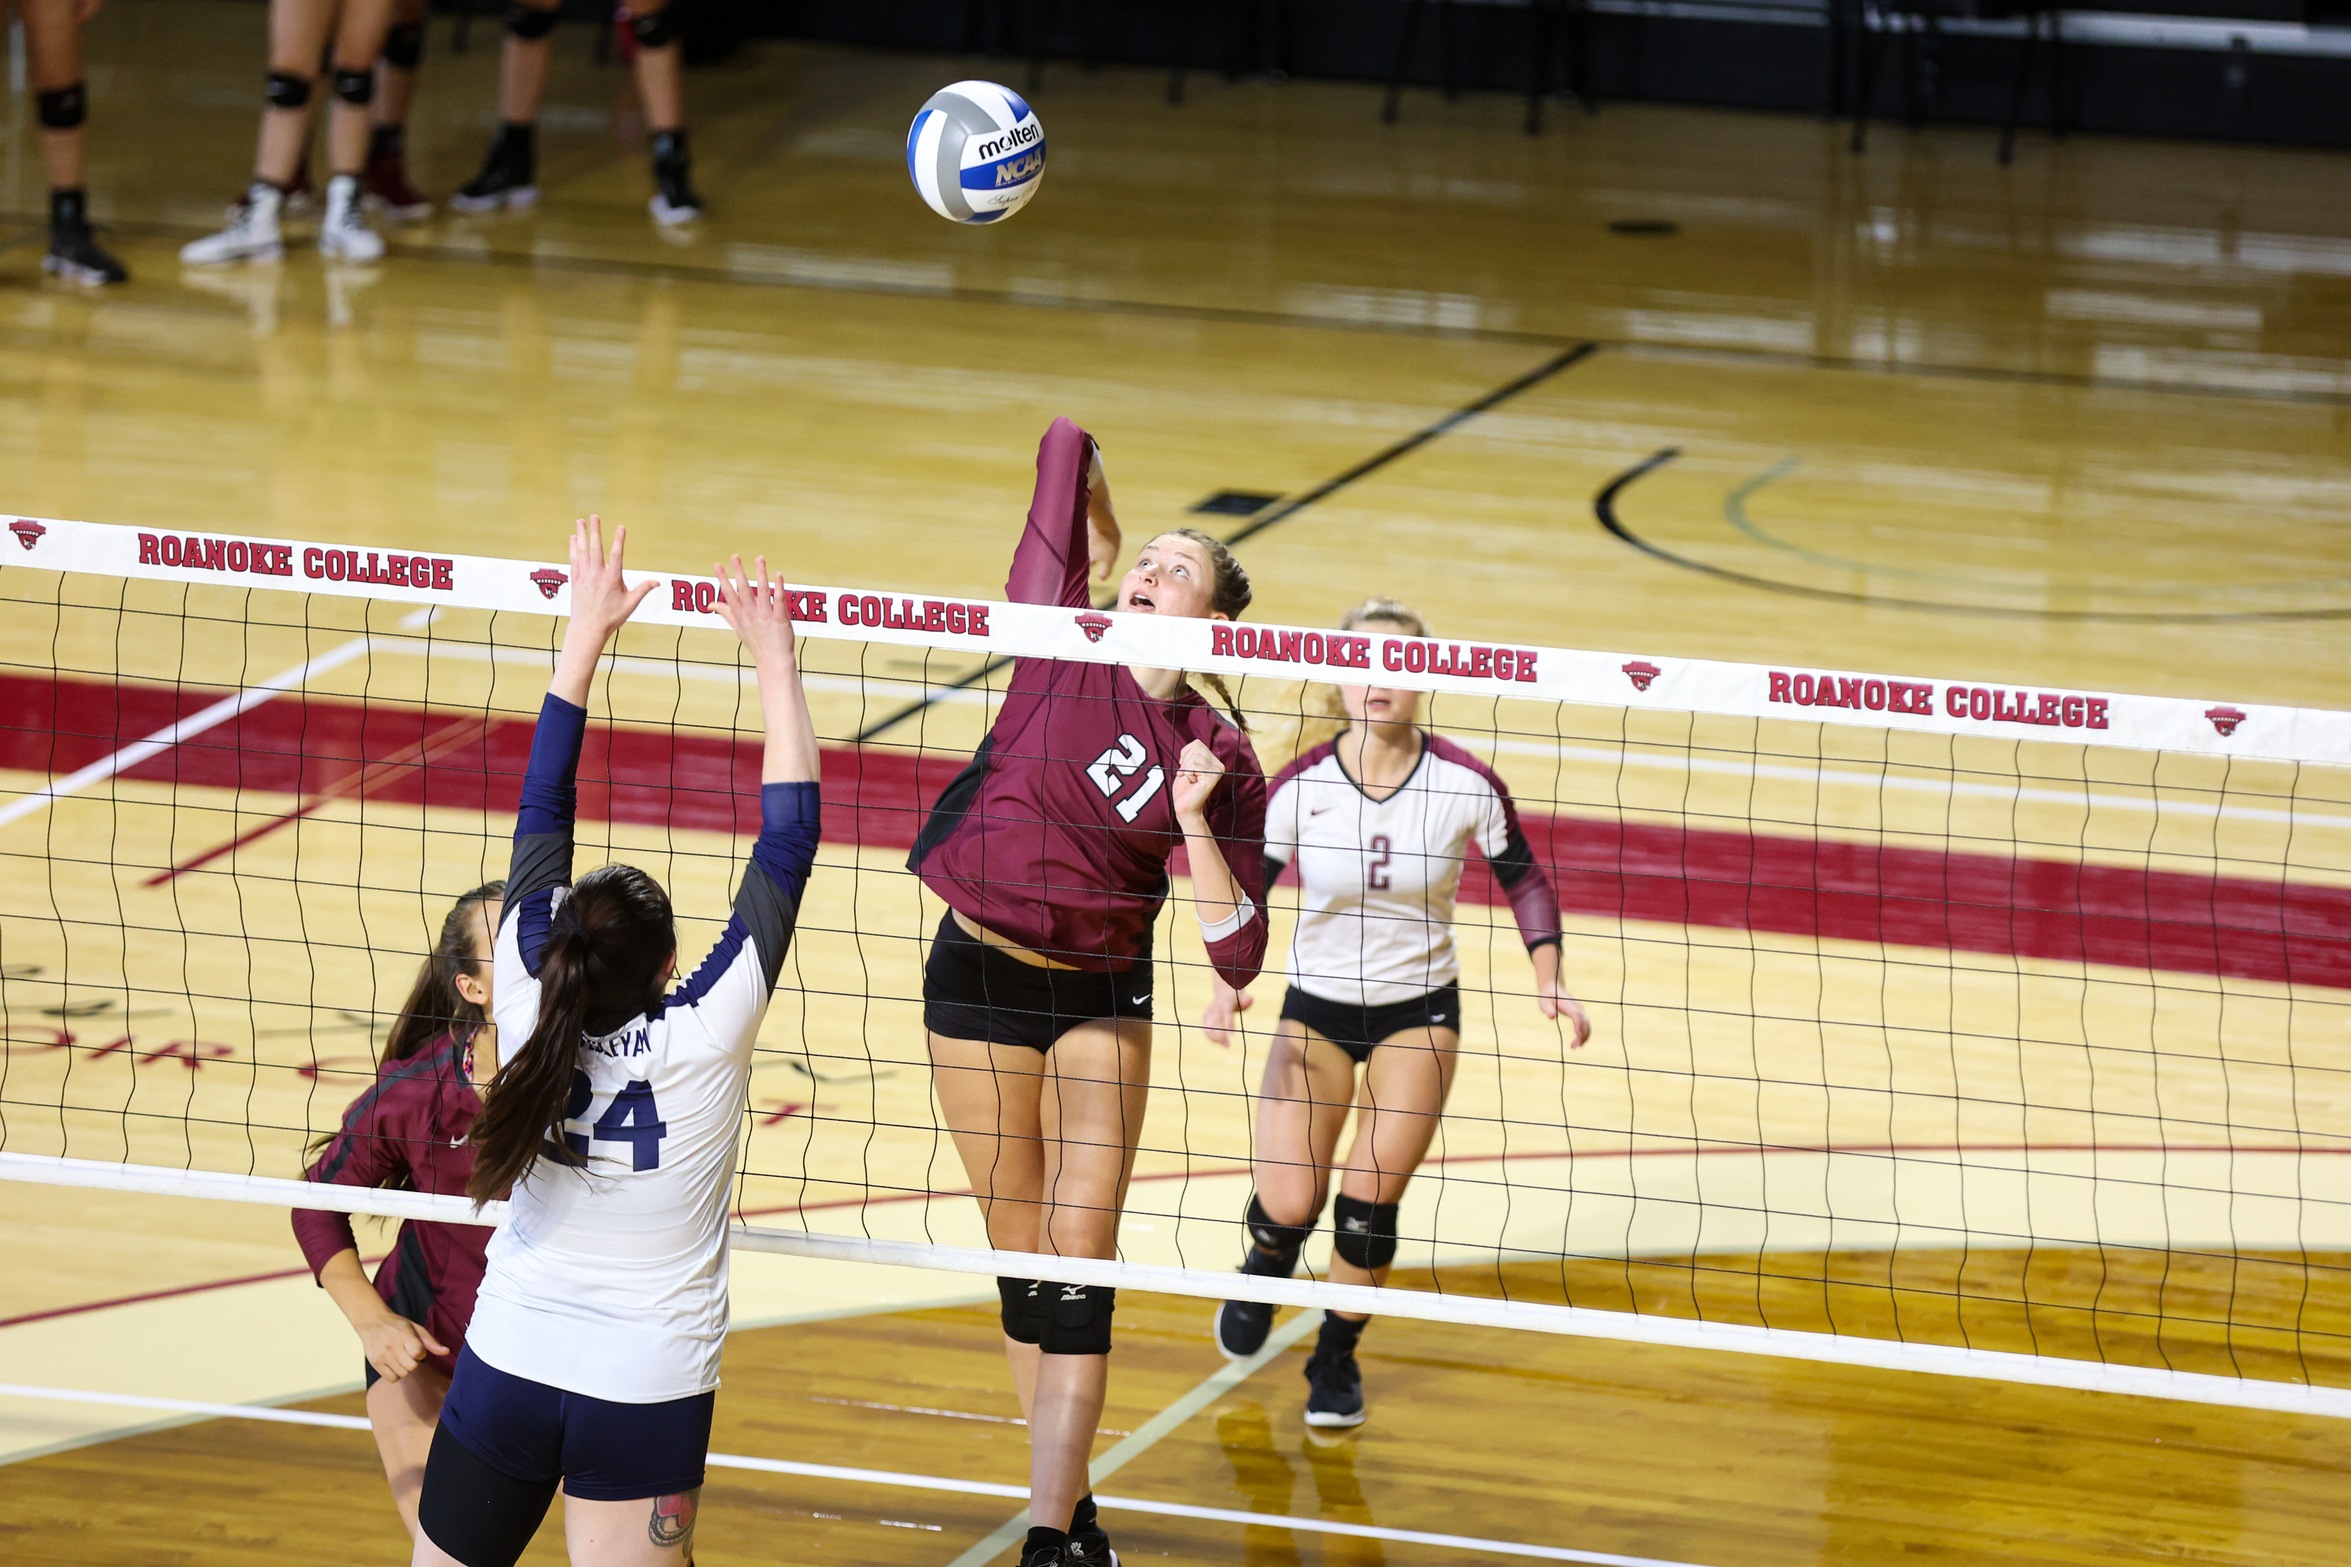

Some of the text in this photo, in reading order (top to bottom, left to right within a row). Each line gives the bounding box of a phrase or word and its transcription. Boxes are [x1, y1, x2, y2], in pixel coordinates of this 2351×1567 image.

[978, 123, 1039, 160] molten
[995, 148, 1042, 187] NCAA
[137, 532, 454, 591] ROANOKE COLLEGE
[671, 579, 990, 637] ROKE COLLEGE
[1211, 624, 1538, 683] ROANOKE COLLEGE
[1768, 671, 2109, 730] ROANOKE COLLEGE
[1085, 732, 1166, 825] 21
[1367, 833, 1392, 892] 2
